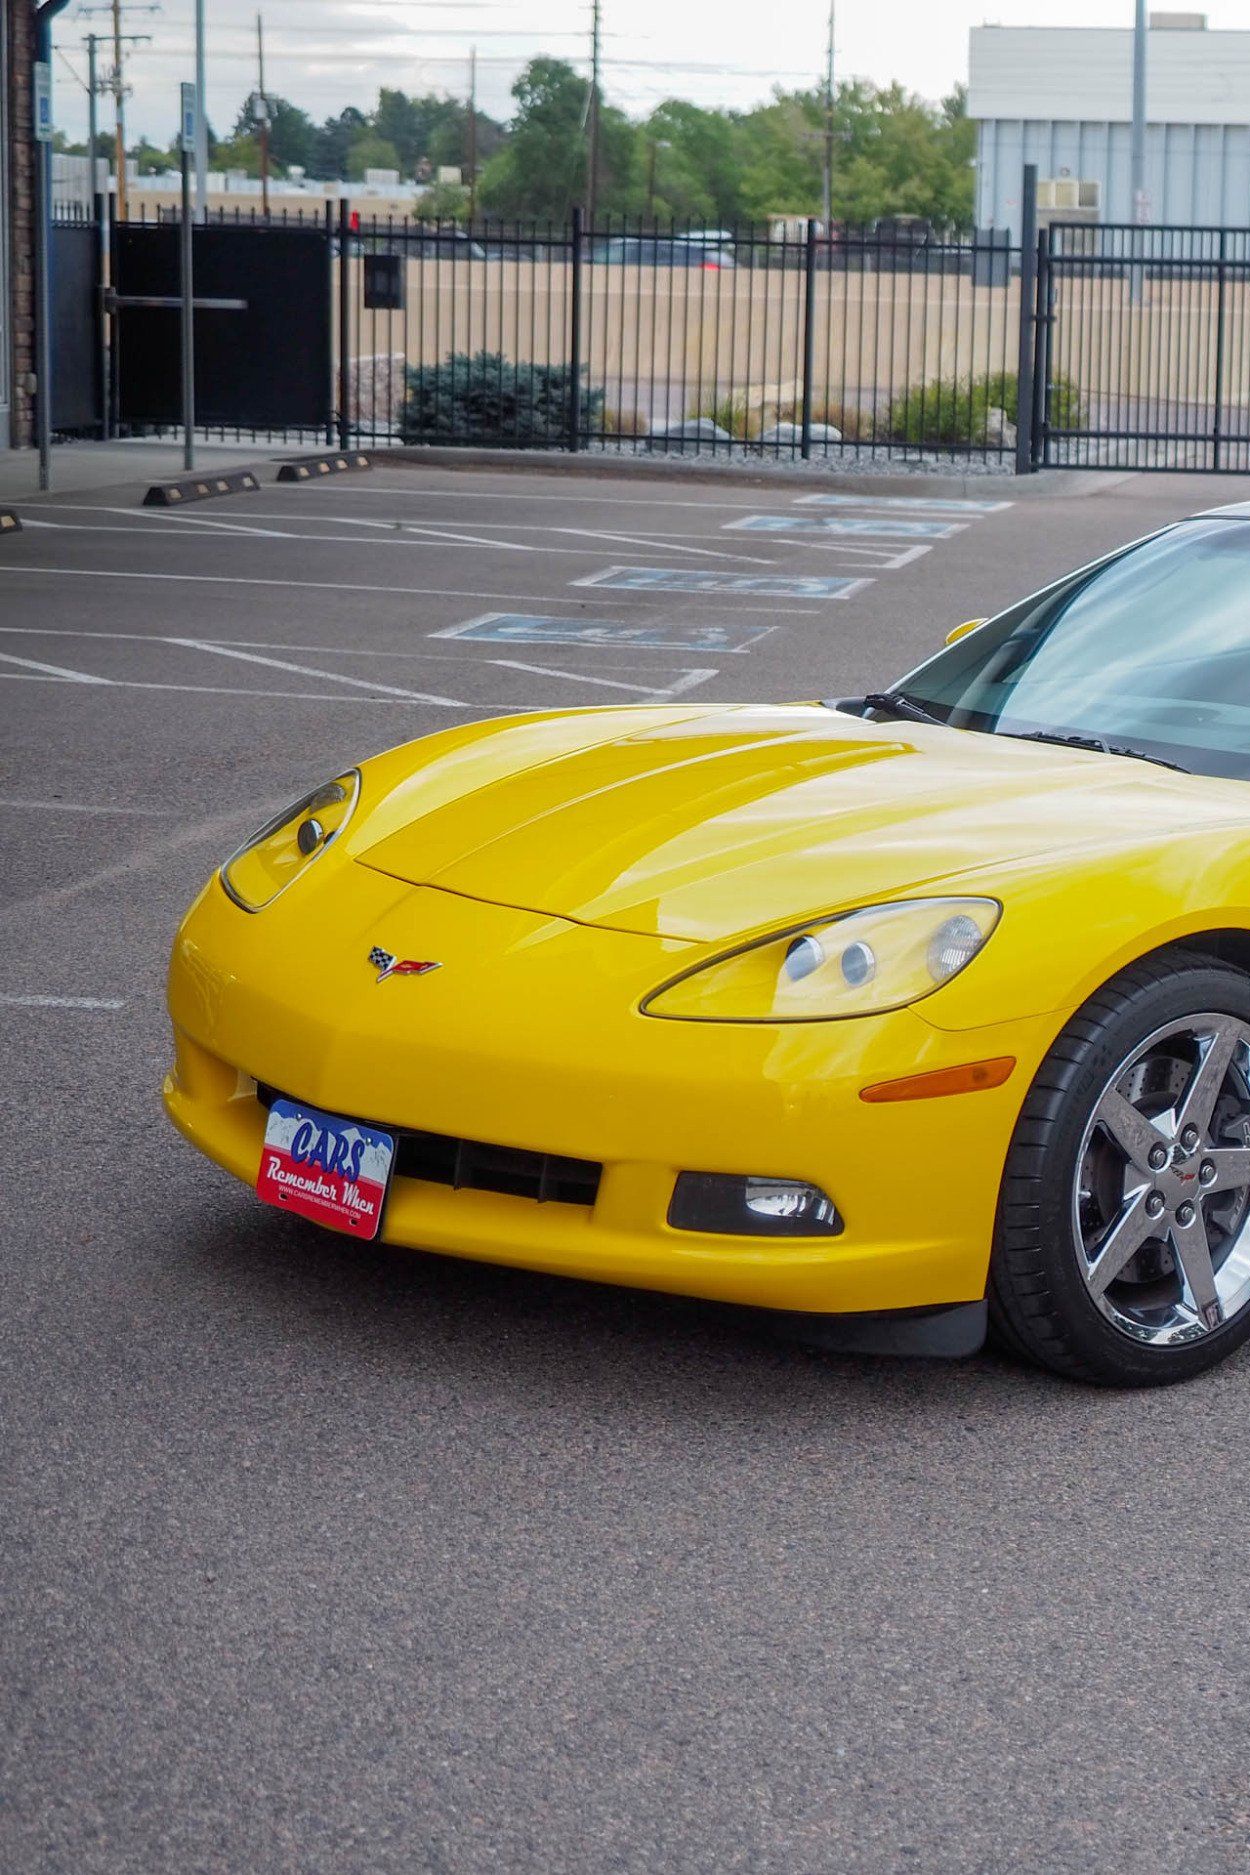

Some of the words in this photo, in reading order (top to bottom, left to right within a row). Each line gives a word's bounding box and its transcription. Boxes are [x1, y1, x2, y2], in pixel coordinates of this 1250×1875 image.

[291, 1121, 365, 1184] CARS
[266, 1156, 337, 1201] Remember
[341, 1181, 375, 1216] When
